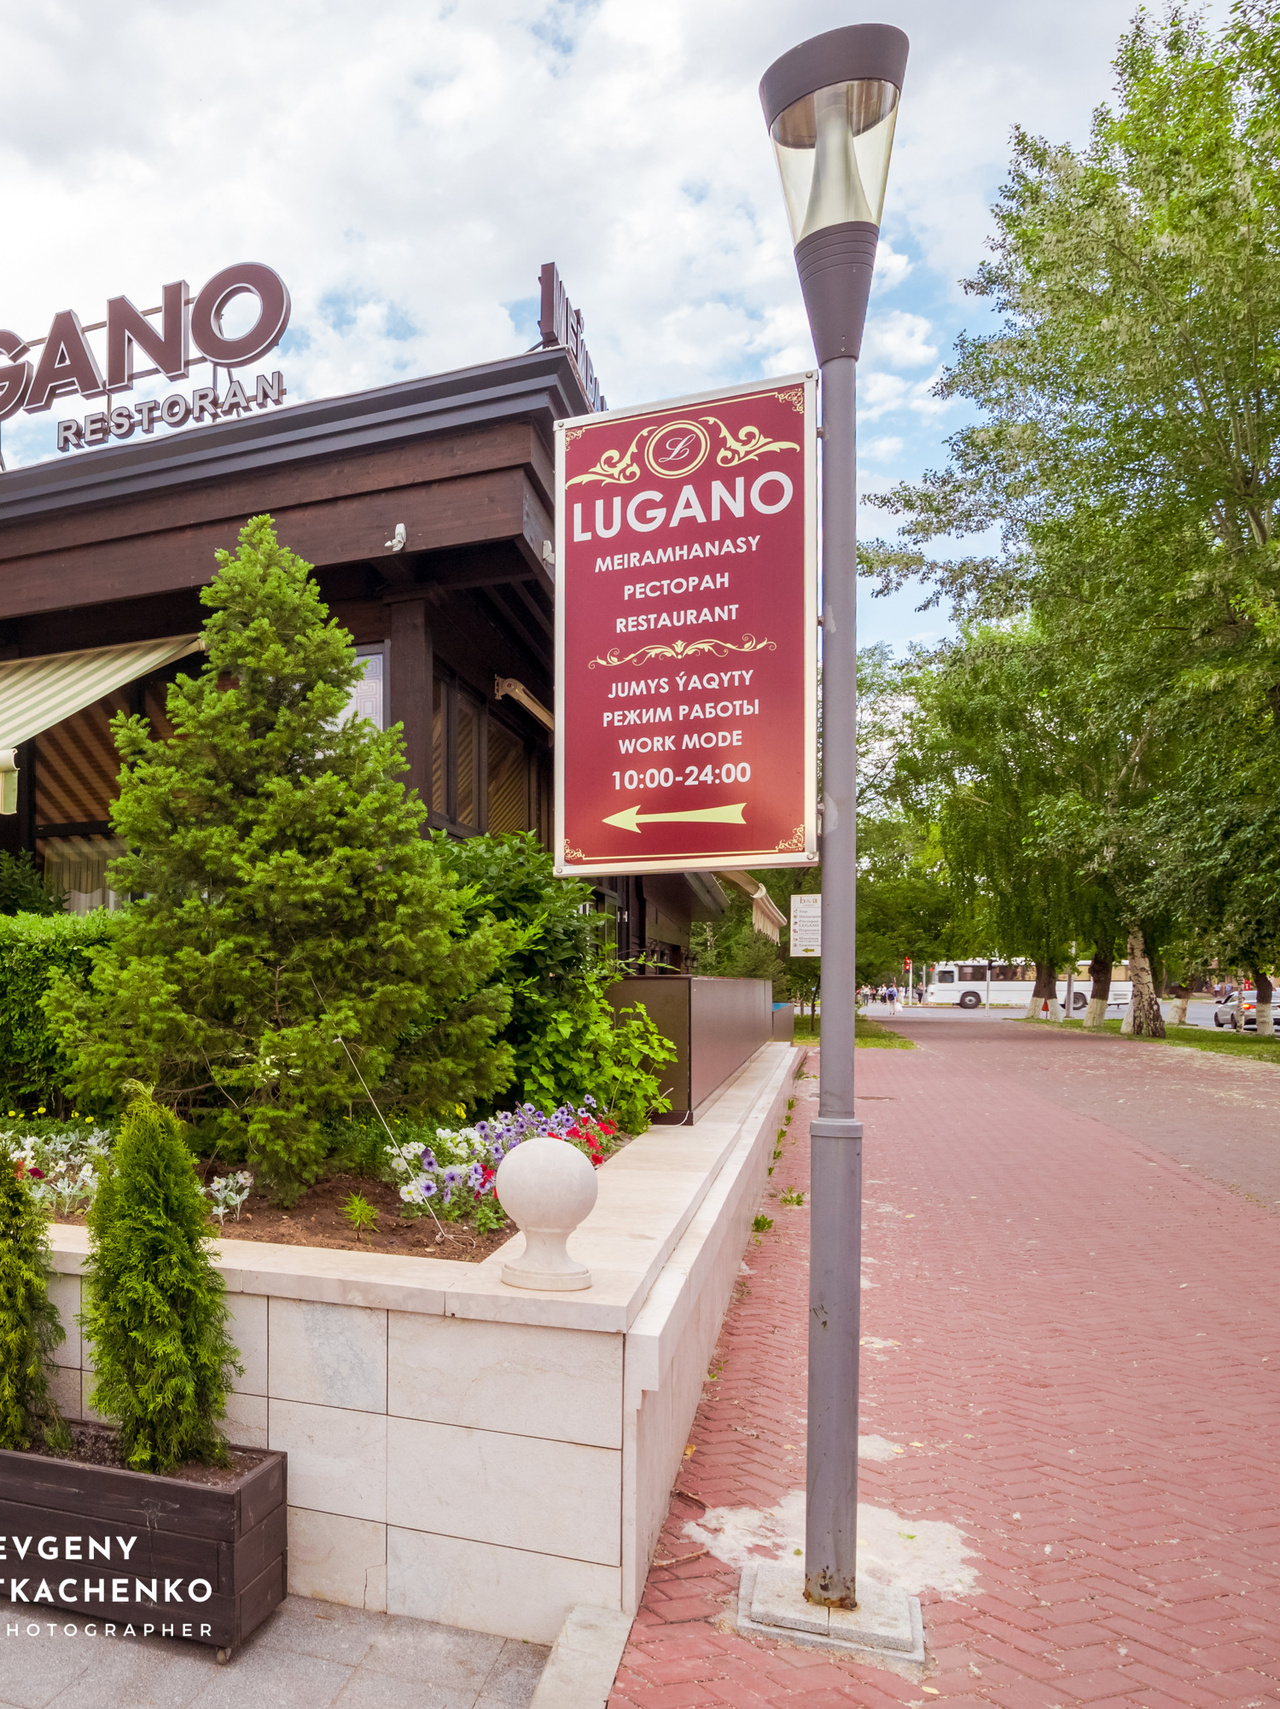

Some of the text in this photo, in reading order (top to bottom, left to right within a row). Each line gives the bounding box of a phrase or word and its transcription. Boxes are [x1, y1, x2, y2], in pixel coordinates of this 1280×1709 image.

[57, 371, 283, 452] RESTORAN
[573, 471, 794, 543] LUGANO
[595, 535, 761, 573] MEIRAMHANASY
[623, 572, 729, 600] РЕСТОРАН
[616, 604, 739, 633] RESTAURANT
[608, 670, 754, 699] JUMYS ÝAQYTY
[603, 698, 759, 727] РЕЖИМ РАБОТЫ
[619, 730, 743, 754] WORK MODE
[612, 762, 752, 790] 10:00-24:00
